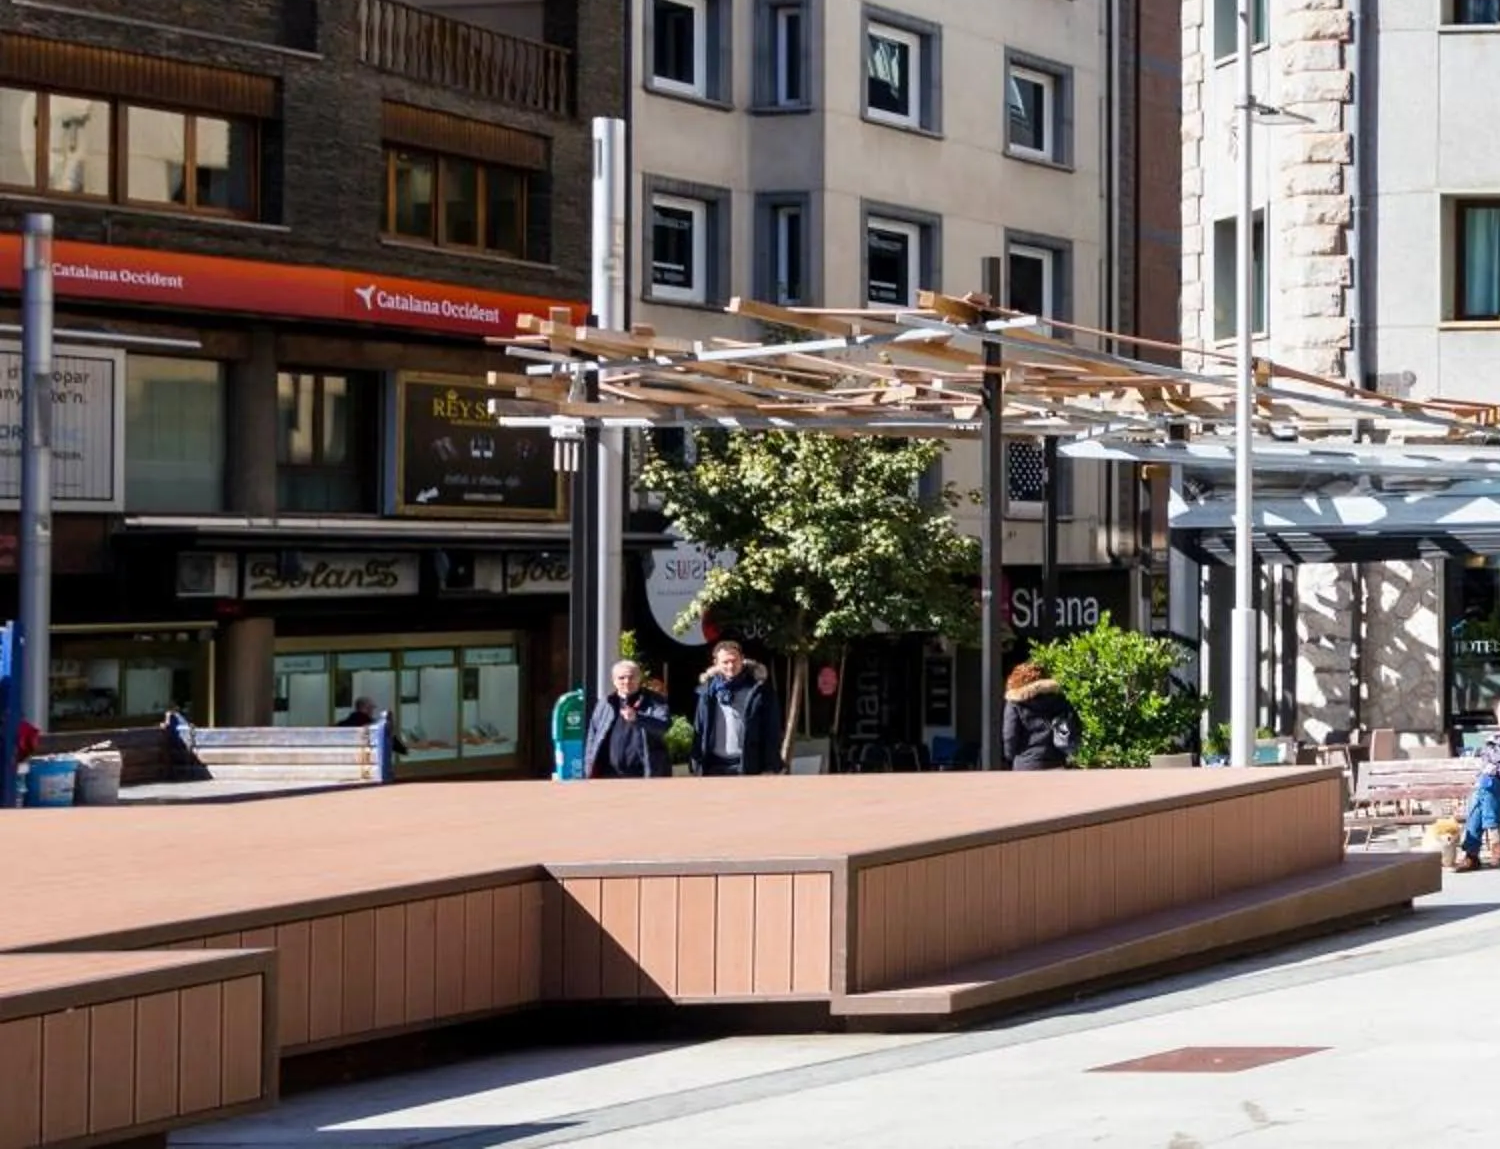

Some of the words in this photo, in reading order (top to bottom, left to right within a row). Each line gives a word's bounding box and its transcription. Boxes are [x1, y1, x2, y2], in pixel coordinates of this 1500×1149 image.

[52, 262, 118, 282] Catalana
[120, 269, 183, 289] Occident
[377, 290, 439, 316] Catalana
[441, 300, 499, 324] Occident
